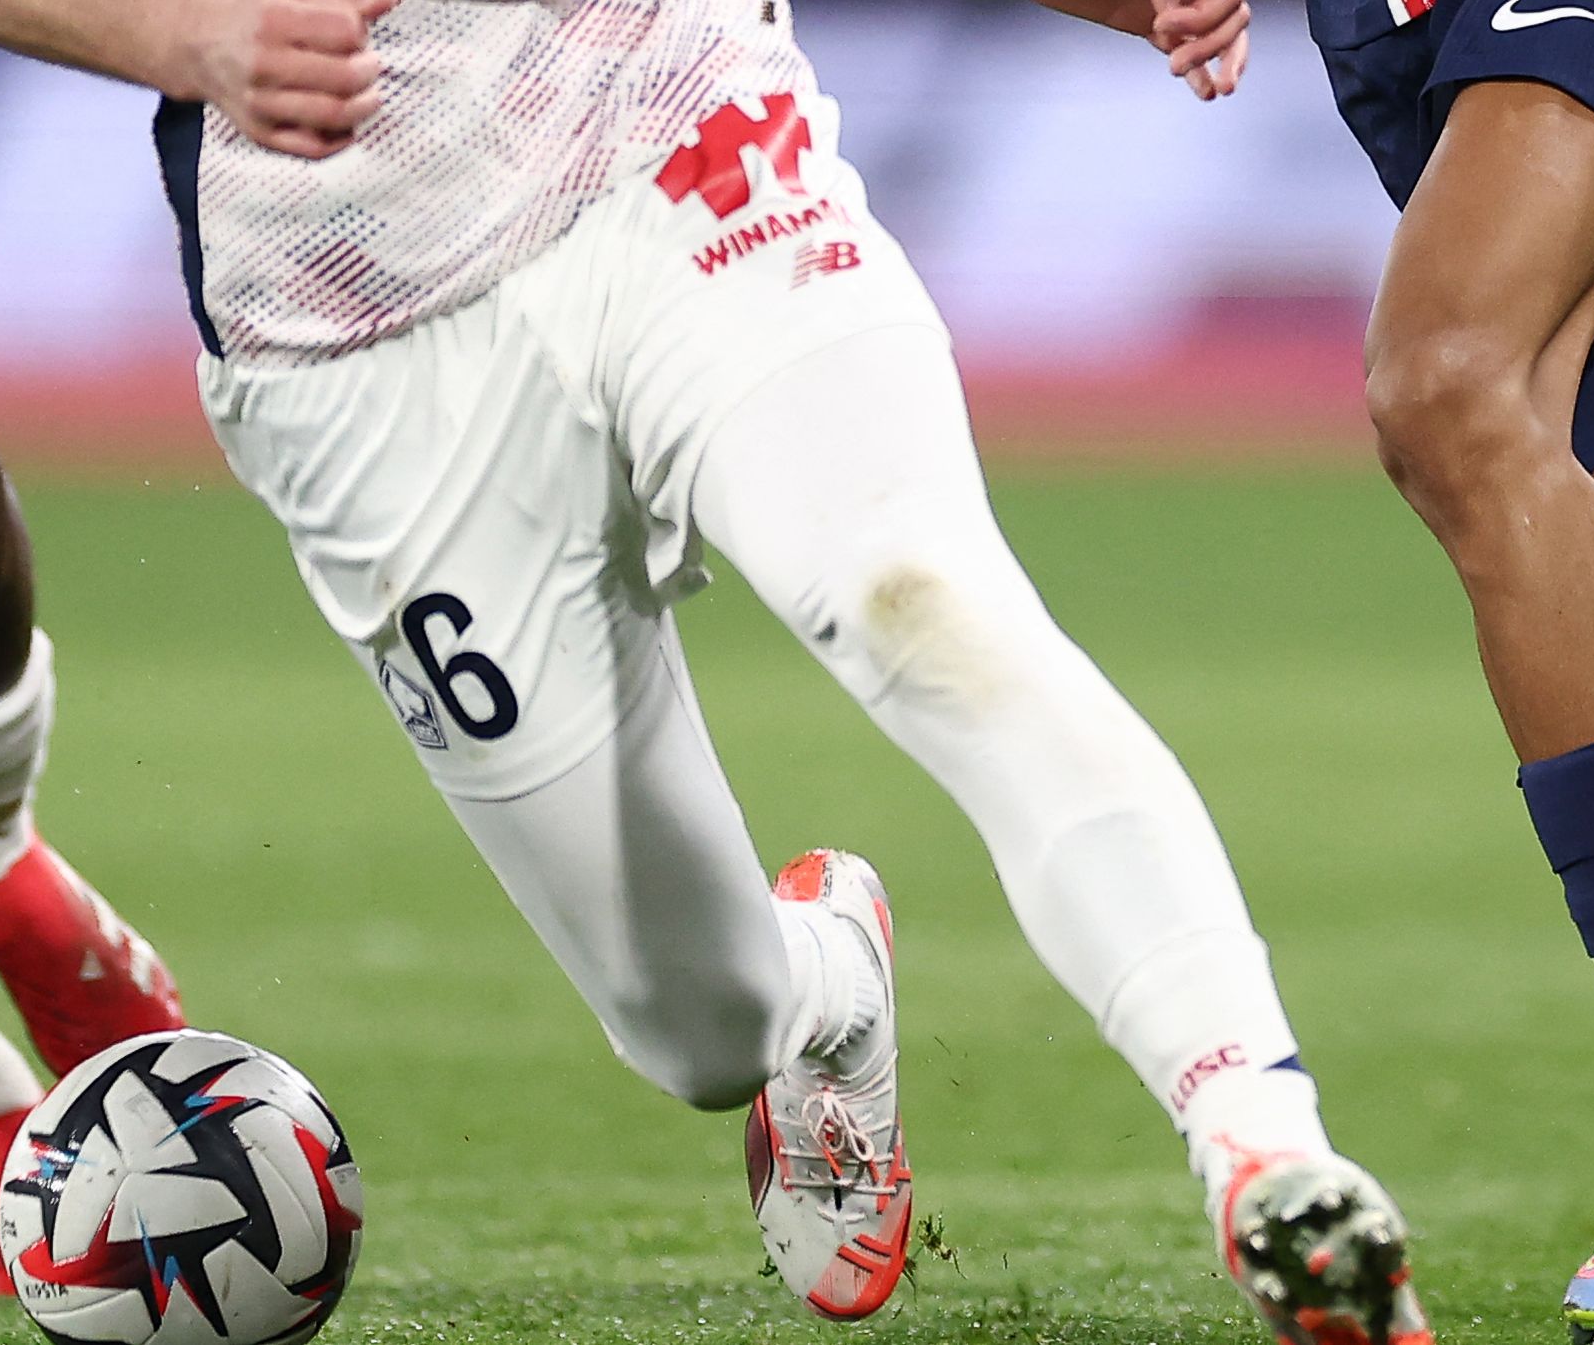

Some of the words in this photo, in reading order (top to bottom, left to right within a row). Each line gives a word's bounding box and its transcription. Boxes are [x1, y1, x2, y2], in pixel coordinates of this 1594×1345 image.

[692, 198, 859, 275] WINAM
[402, 592, 519, 740] 6
[1170, 1043, 1247, 1114] LOSC
